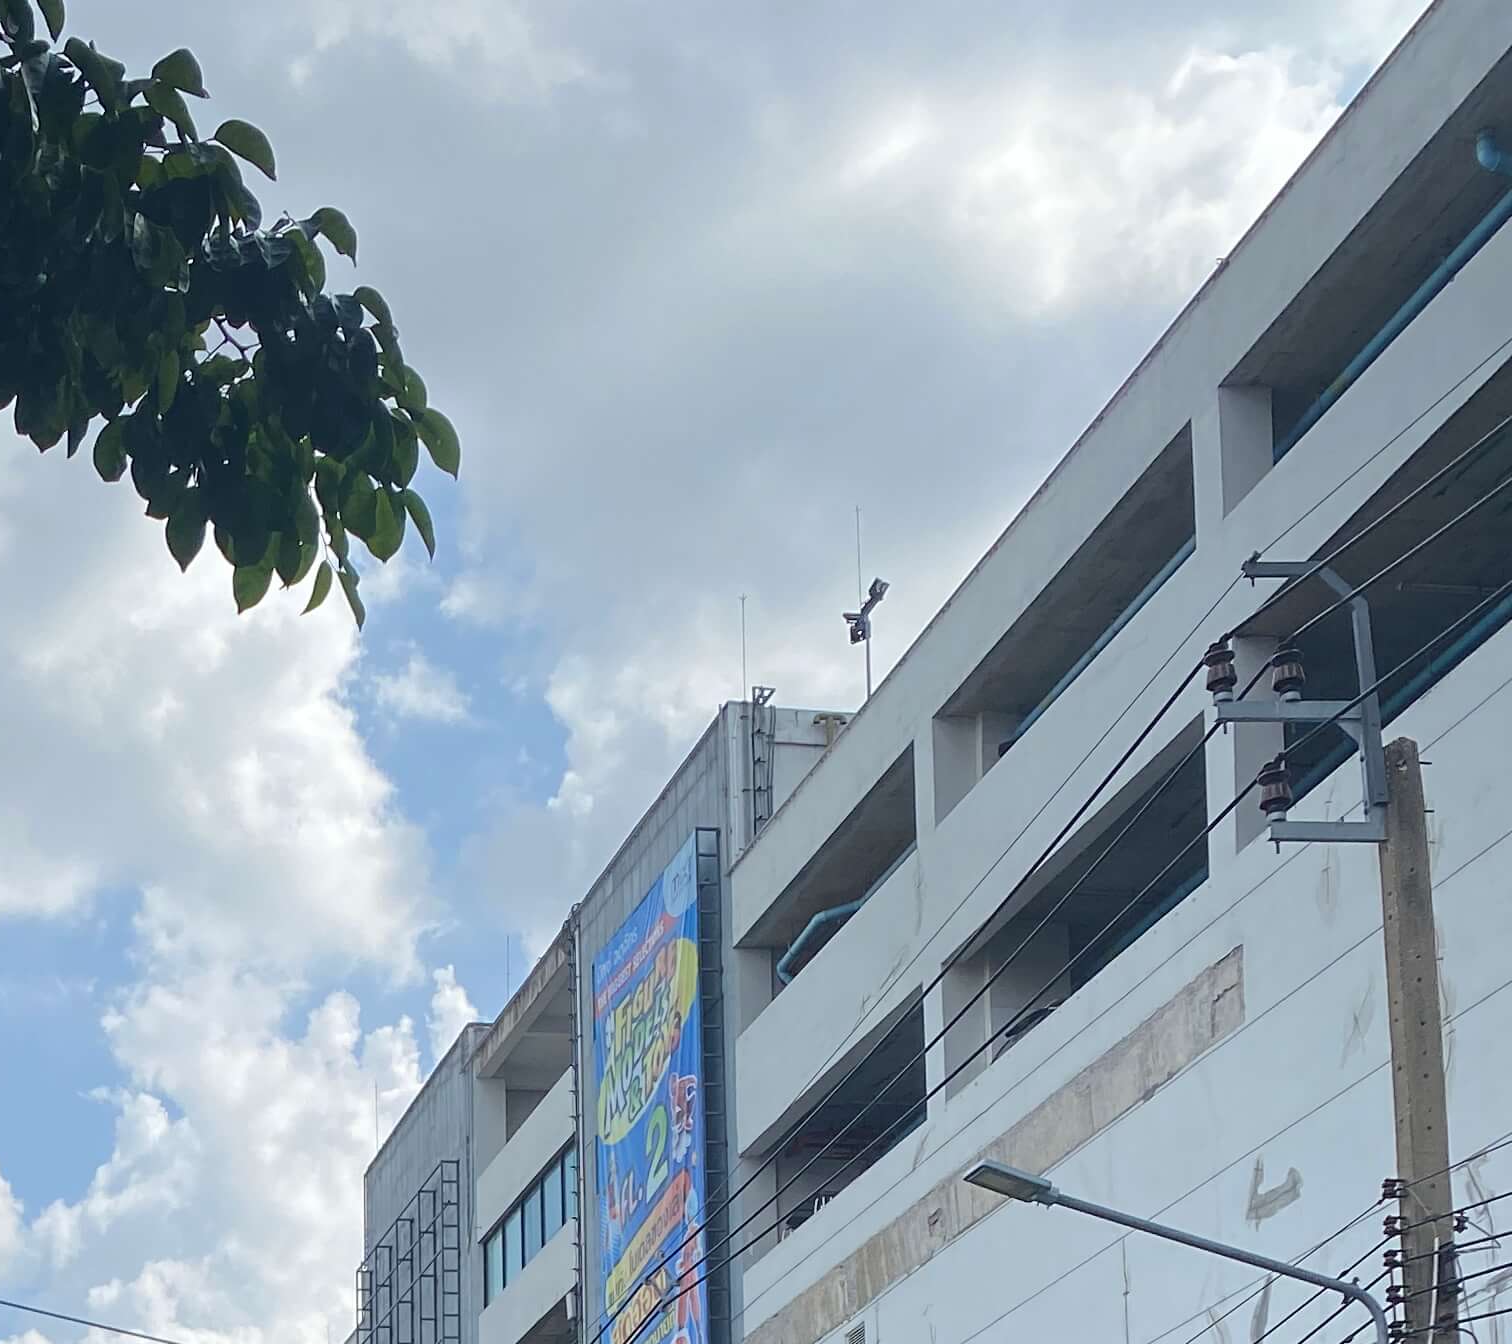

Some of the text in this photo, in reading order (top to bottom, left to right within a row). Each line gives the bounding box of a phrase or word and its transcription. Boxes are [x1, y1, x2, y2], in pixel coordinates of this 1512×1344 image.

[615, 941, 678, 1051] FIGURE
[603, 977, 670, 1139] MODELS
[628, 1075, 642, 1122] &
[646, 1103, 669, 1203] 2
